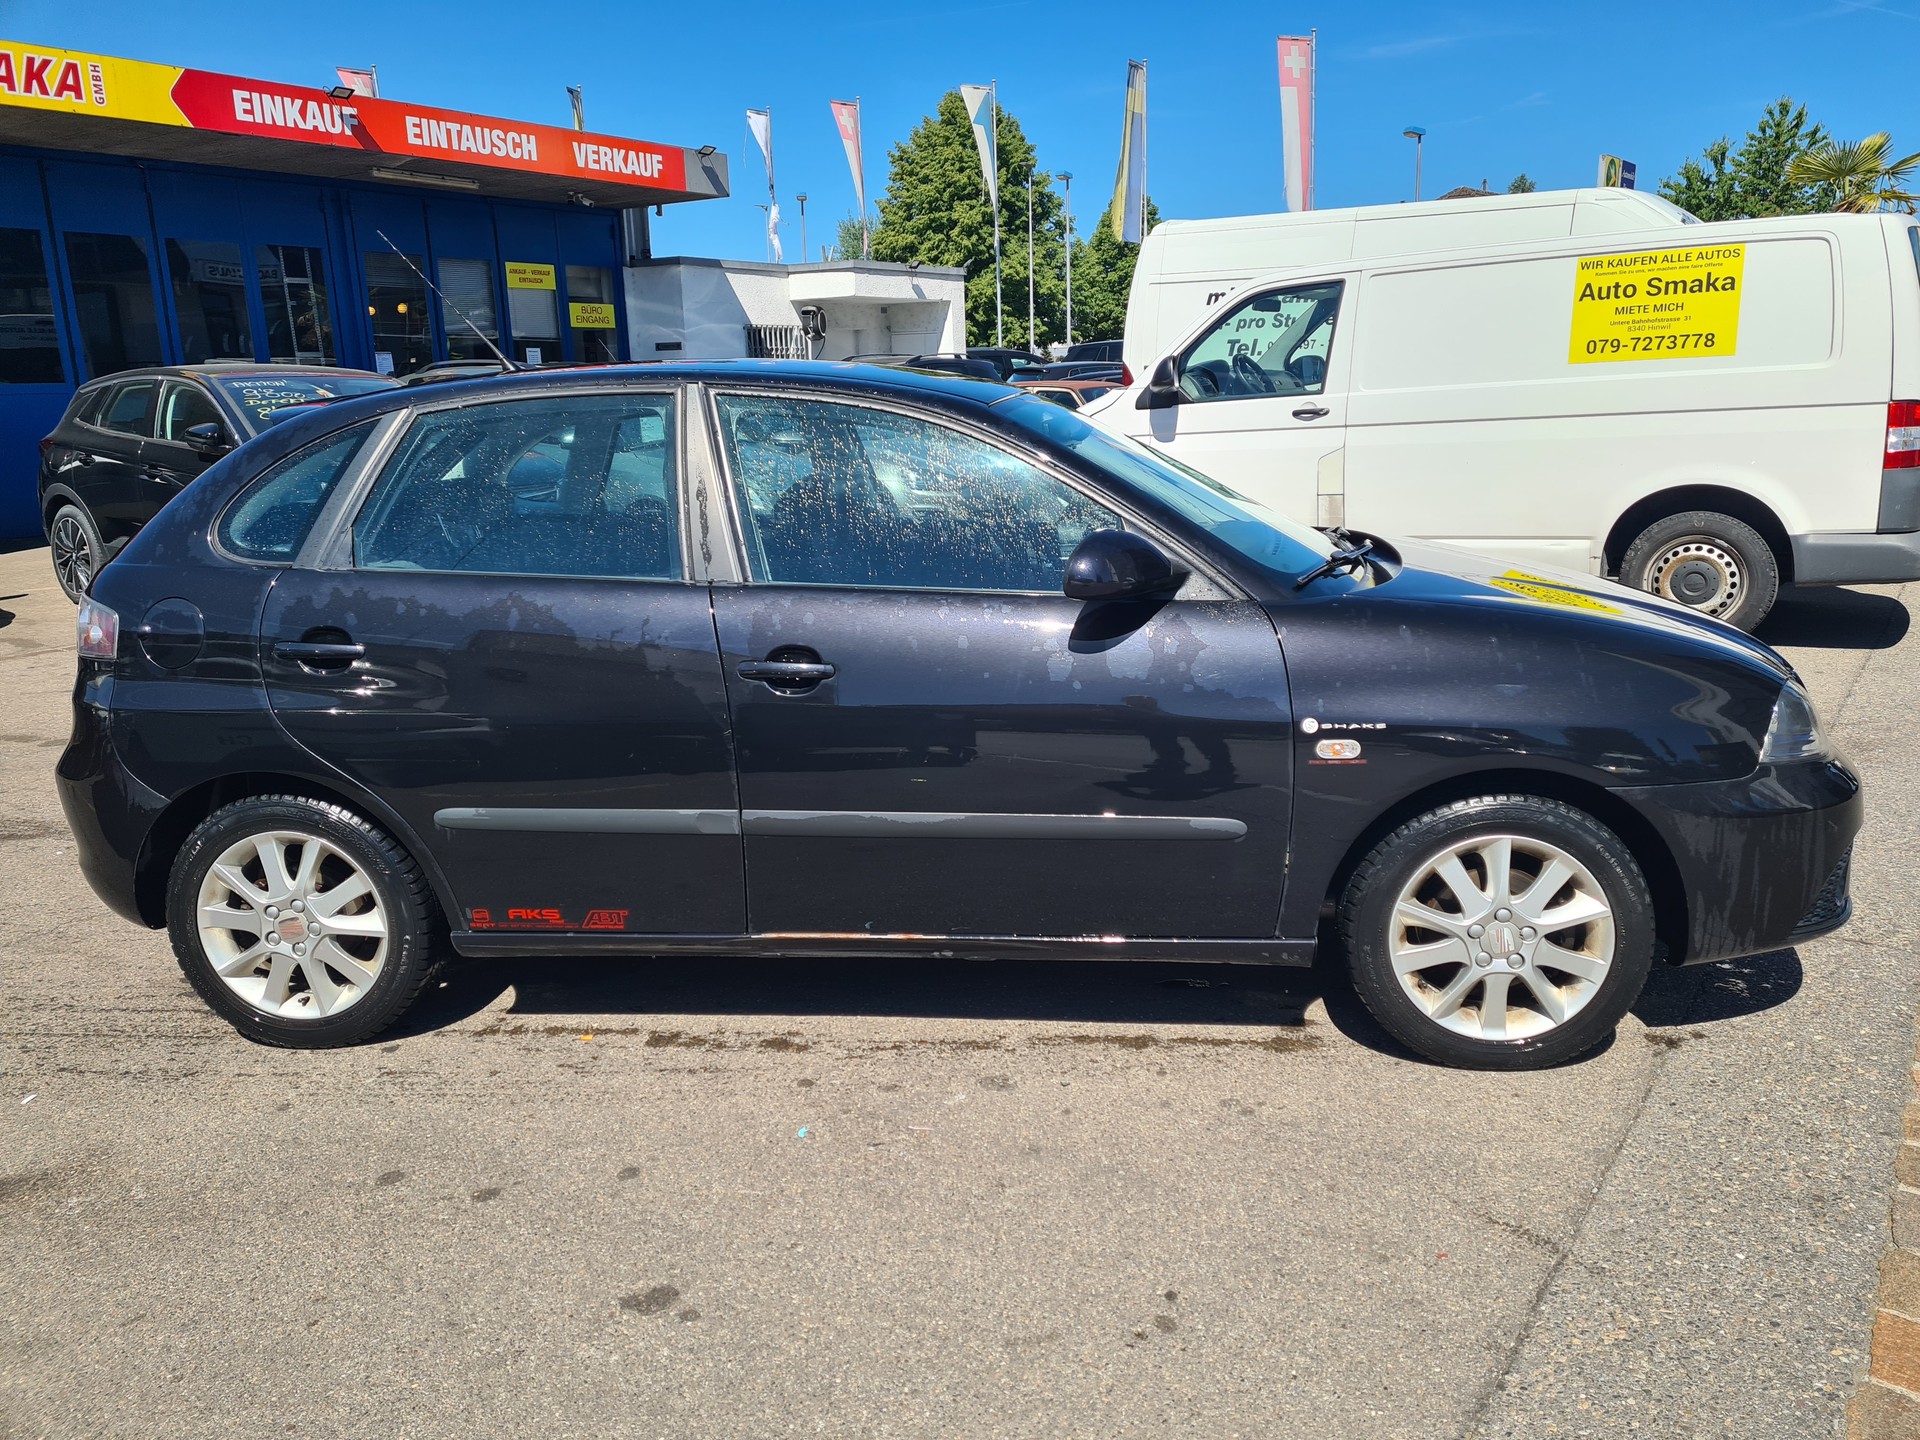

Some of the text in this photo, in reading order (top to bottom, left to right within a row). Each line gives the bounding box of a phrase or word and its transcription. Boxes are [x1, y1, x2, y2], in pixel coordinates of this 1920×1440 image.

[89, 63, 106, 105] GMBH
[232, 89, 359, 136] EINKAUF
[405, 115, 538, 161] EINTAUSCH
[571, 141, 663, 178] VERKAUF
[1580, 248, 1741, 271] WIR KAUFEN ALLE AUTOS
[1578, 271, 1736, 302] Auto Smaka
[581, 305, 603, 315] BÜRO
[1614, 302, 1685, 316] MIETE MICH
[575, 315, 610, 324] EINGANG
[1235, 316, 1266, 332] pro
[1627, 323, 1671, 332] 8340 Hinwil
[1631, 315, 1681, 325] Bahnhofstrasse
[1226, 338, 1263, 357] Tel.
[1586, 332, 1716, 355] 079-7273778
[507, 908, 561, 920] AKS
